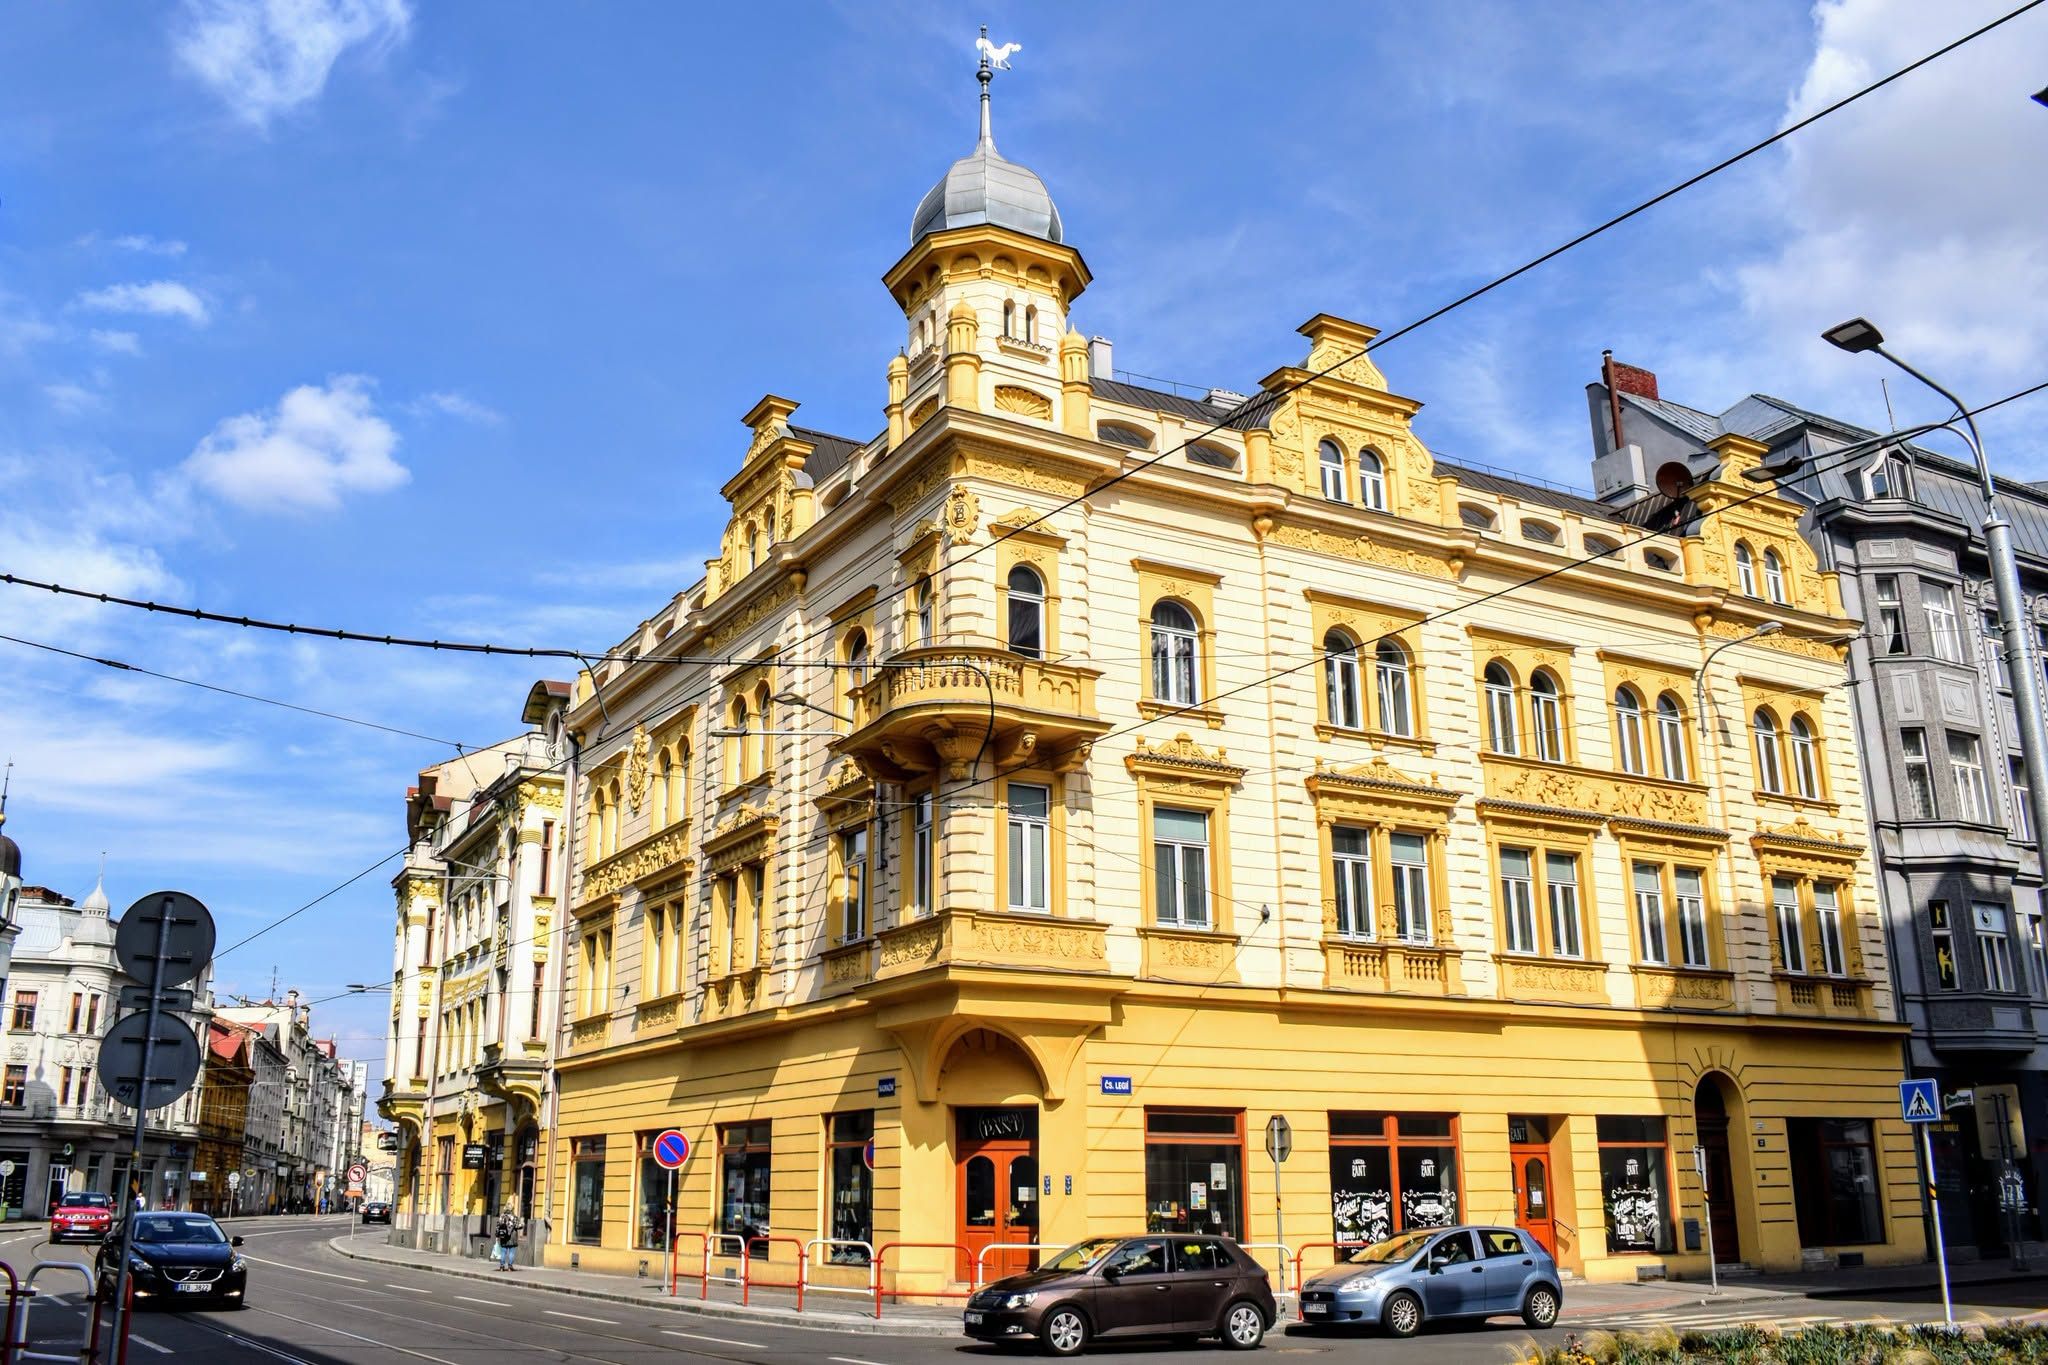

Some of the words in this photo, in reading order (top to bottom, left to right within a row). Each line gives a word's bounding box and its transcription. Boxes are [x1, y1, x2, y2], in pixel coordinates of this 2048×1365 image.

[1352, 1165, 1366, 1177] PANT
[1421, 1165, 1435, 1177] PANT
[1626, 1165, 1639, 1176] PANT
